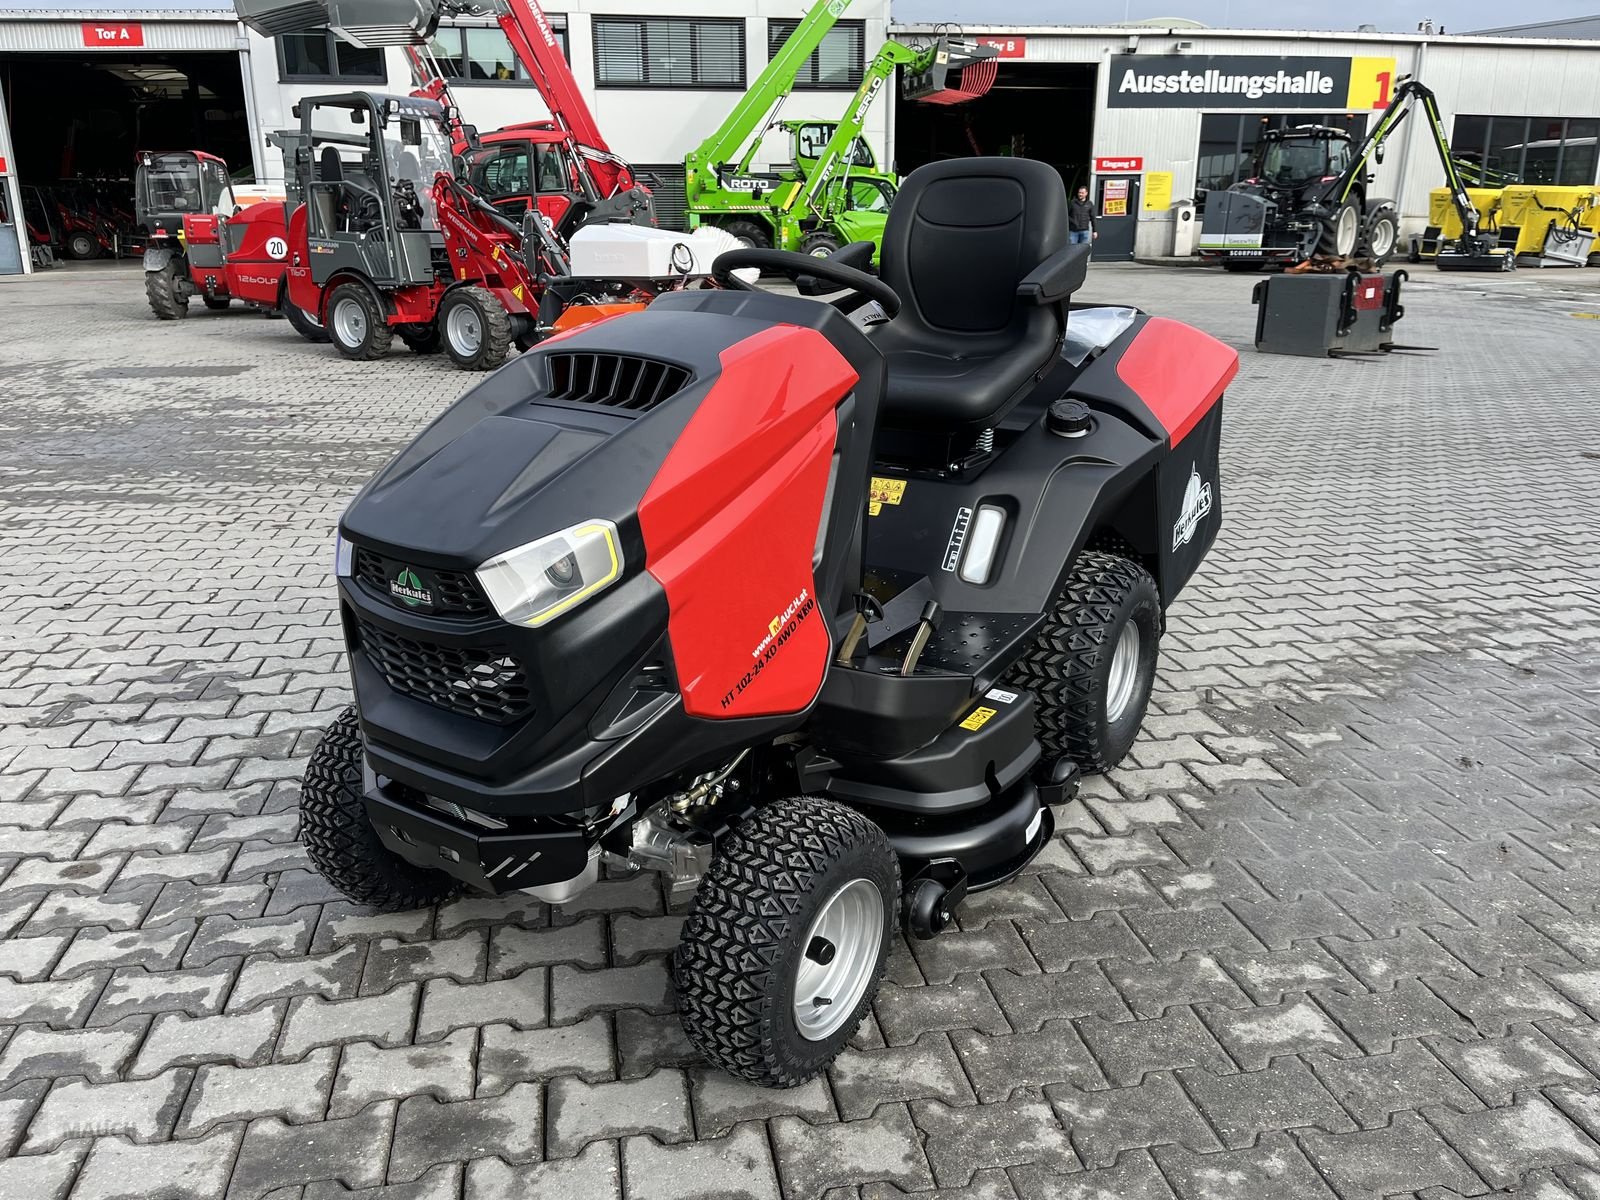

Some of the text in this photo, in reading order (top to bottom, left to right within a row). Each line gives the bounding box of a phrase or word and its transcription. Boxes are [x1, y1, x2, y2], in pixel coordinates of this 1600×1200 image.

[95, 27, 130, 40] Tor A
[1006, 40, 1015, 52] B
[1118, 69, 1391, 109] Ausstellungshalle 1
[852, 76, 883, 125] MERLO
[1102, 160, 1130, 169] Eingang
[731, 179, 769, 189] ROTO
[447, 211, 478, 242] WEIDEMANN
[270, 241, 283, 254] 20
[238, 274, 278, 284] 1260LP
[1175, 485, 1210, 543] Herkules
[752, 588, 808, 658] www.MAUCH.at
[721, 598, 814, 709] HT 102-24 XD 4WD NEO
